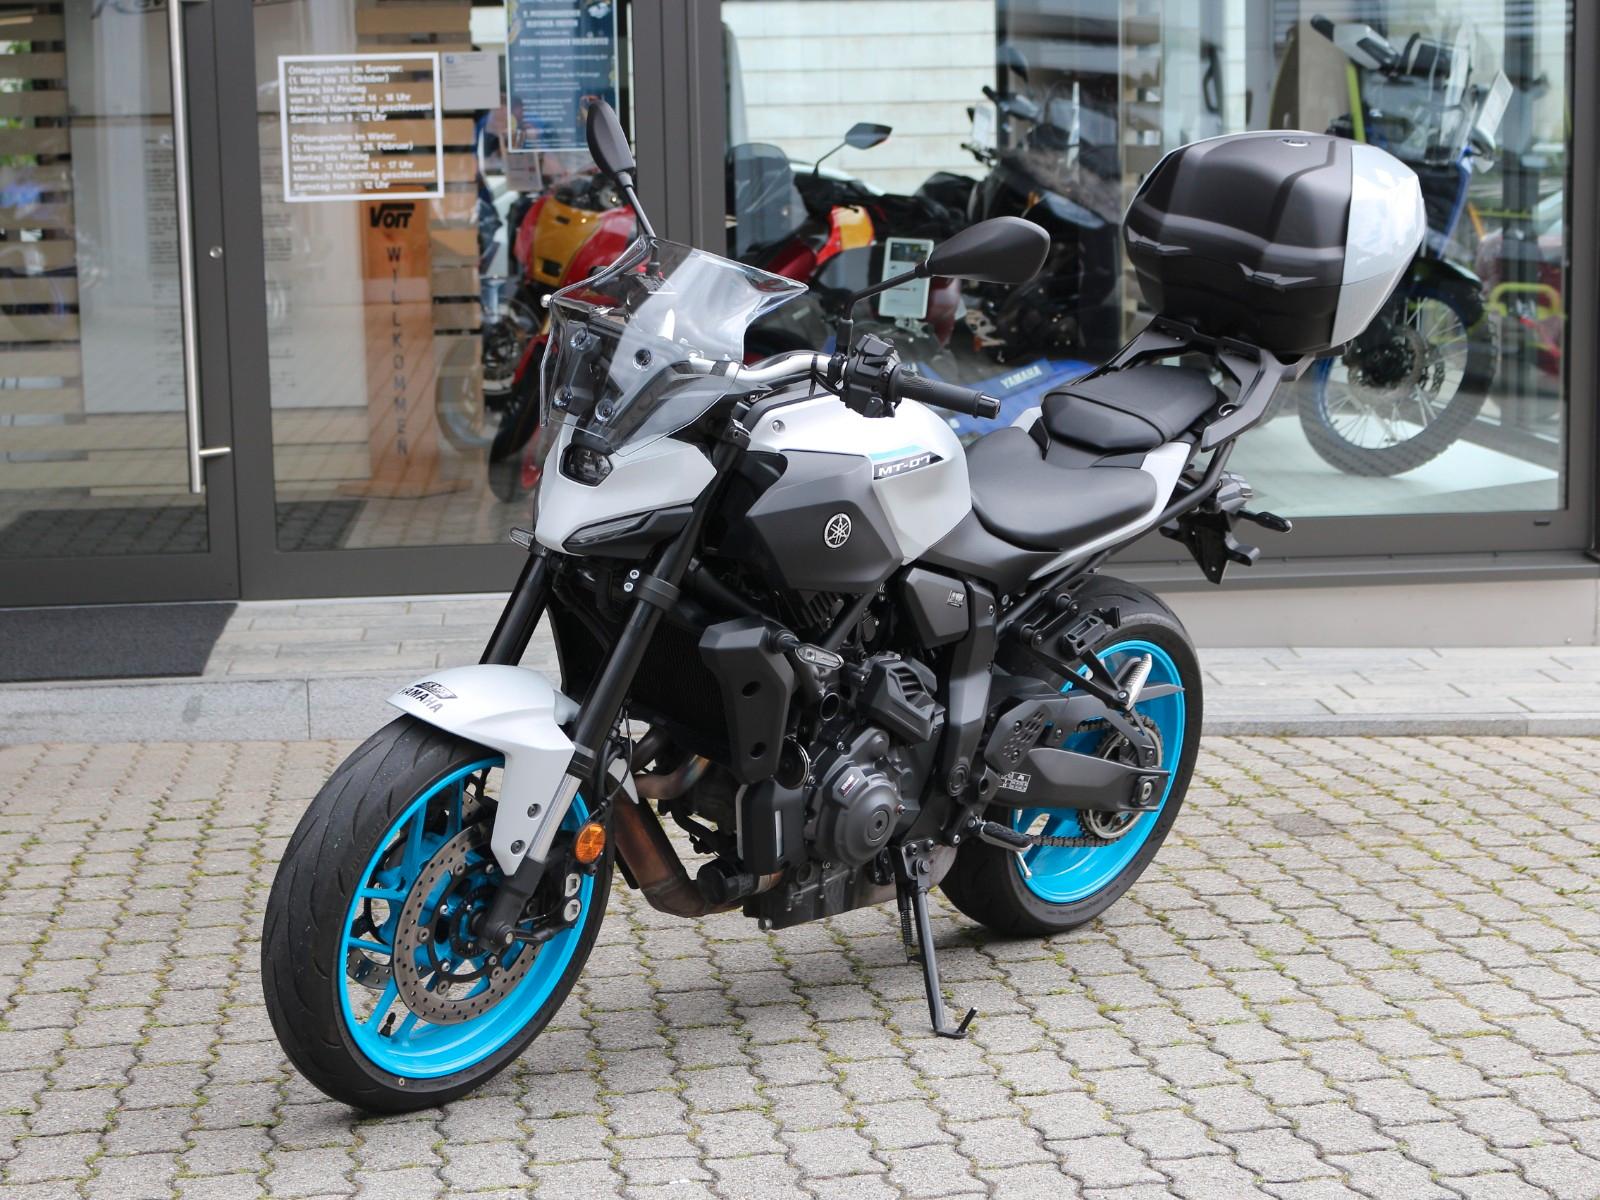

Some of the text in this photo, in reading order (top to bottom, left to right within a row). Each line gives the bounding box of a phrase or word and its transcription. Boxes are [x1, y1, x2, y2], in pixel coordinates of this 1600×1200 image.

[301, 76, 321, 84] März
[352, 74, 389, 83] Oktober)
[289, 87, 320, 95] Montag
[338, 85, 367, 94] Freitag
[350, 94, 365, 102] und
[396, 93, 411, 101] Uhr
[289, 102, 433, 113] Mittwoch Nachmittag geschlossen!
[290, 115, 327, 124] Samstag
[372, 113, 387, 121] Uhr
[348, 143, 360, 151] bis
[378, 142, 413, 151] Februar)
[292, 154, 323, 162] Montag
[340, 153, 369, 161] Freitag
[293, 170, 435, 181] Mittwoch Nachmittag geschlossen!
[294, 183, 330, 191] Samstag
[375, 181, 390, 189] Uhr
[386, 247, 408, 456] WILLKOMMEN
[1000, 364, 1043, 389] YAMAHA
[878, 454, 931, 477] MT-07
[398, 687, 443, 713] YAMAHA
